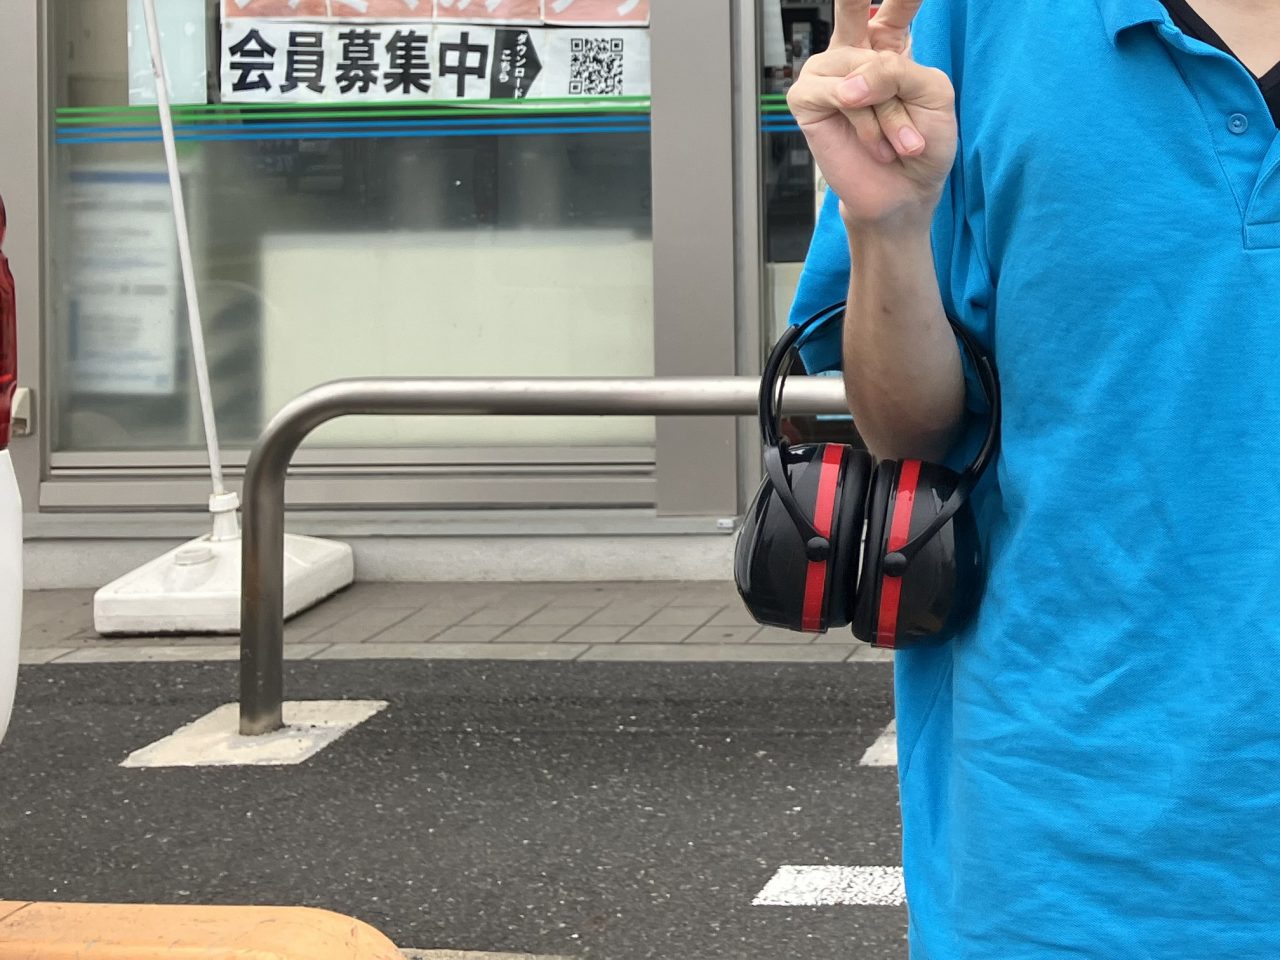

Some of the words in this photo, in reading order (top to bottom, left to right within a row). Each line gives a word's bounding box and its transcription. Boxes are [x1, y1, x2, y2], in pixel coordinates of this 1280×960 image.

[228, 29, 489, 98] 会員募集中
[499, 49, 512, 83] こちら
[514, 32, 528, 99] ダウンロード
